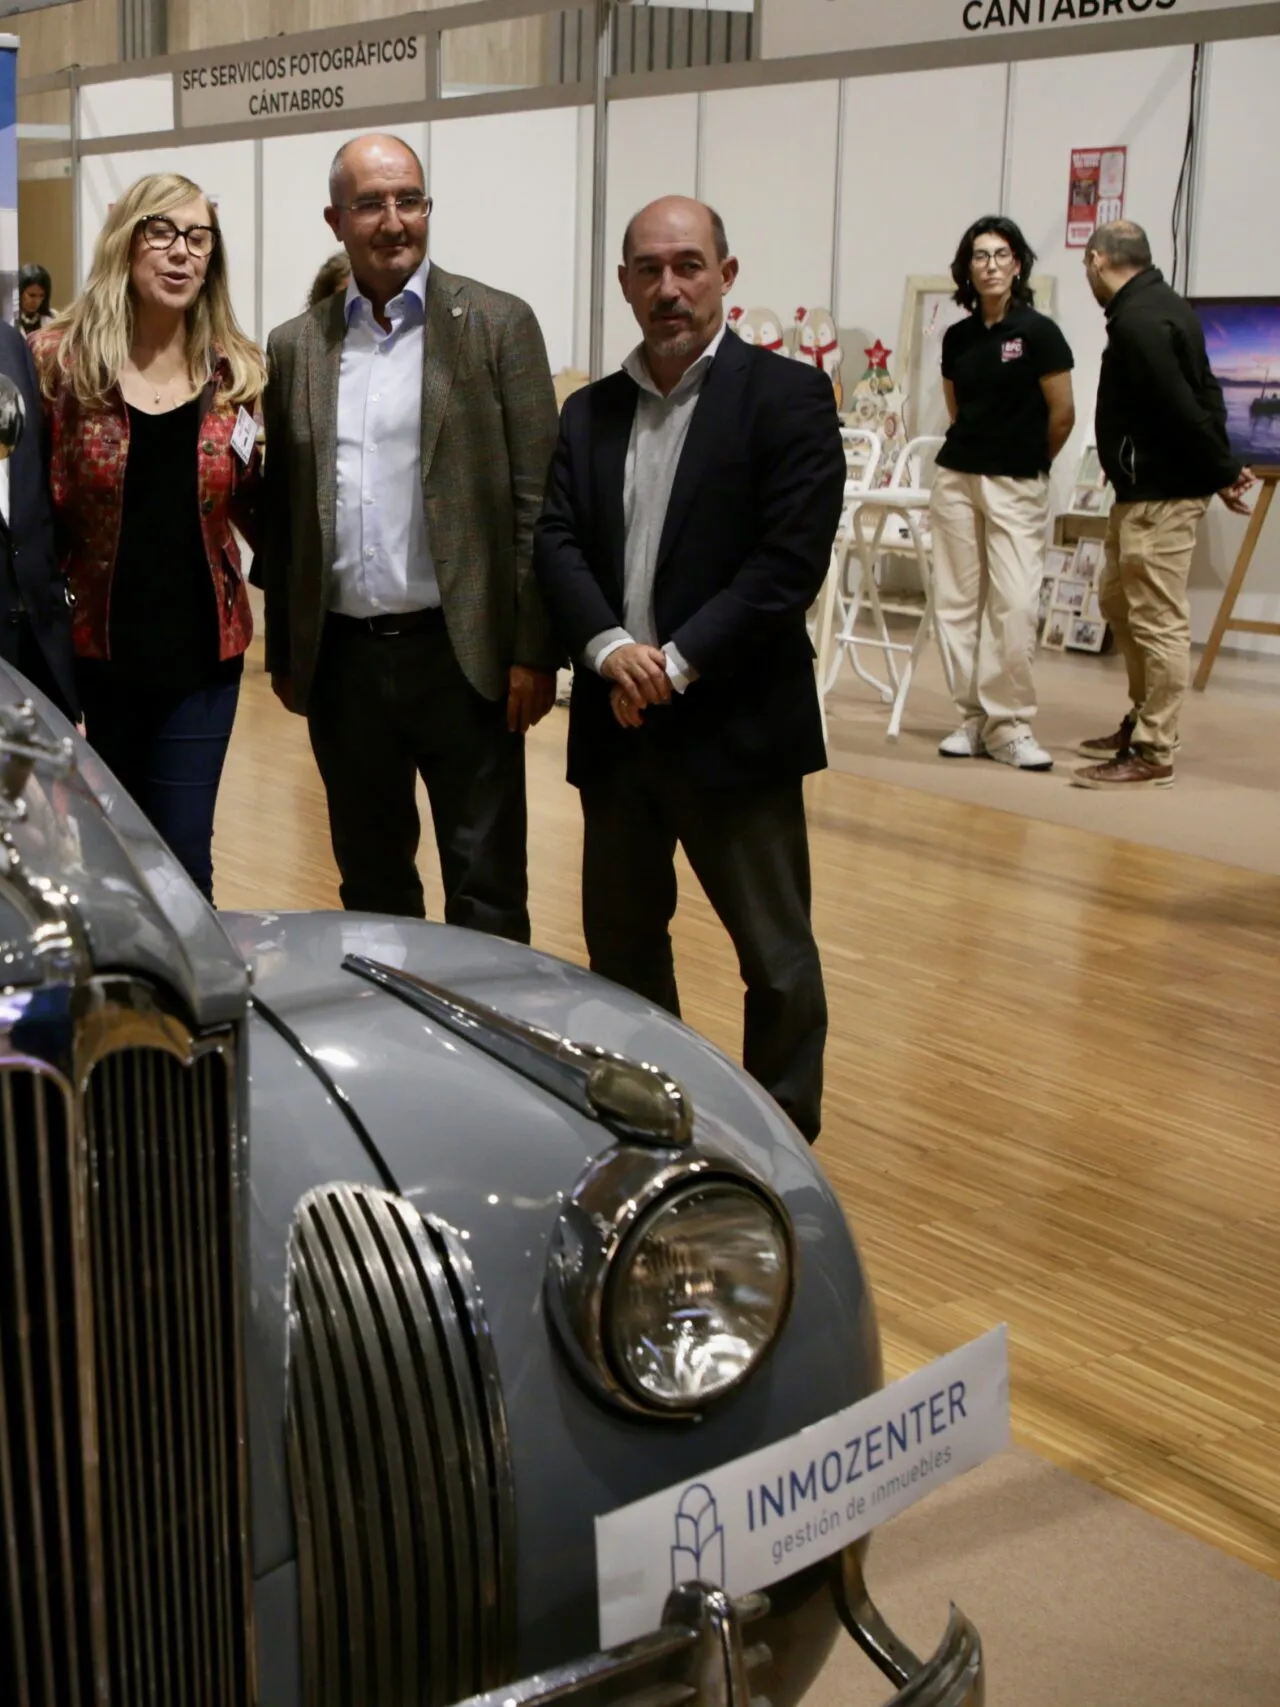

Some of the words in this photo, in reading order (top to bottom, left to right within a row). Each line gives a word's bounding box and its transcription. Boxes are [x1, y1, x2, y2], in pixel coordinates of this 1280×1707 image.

[182, 68, 207, 90] SFC
[210, 57, 286, 87] SERVICIOS
[290, 36, 418, 77] FOTOGRÁFICOS
[248, 86, 344, 115] CÁNTABROS
[746, 1380, 967, 1532] INMOZENTER
[771, 1508, 840, 1565] gestión
[846, 1495, 866, 1521] de
[871, 1445, 952, 1506] inmuebles
